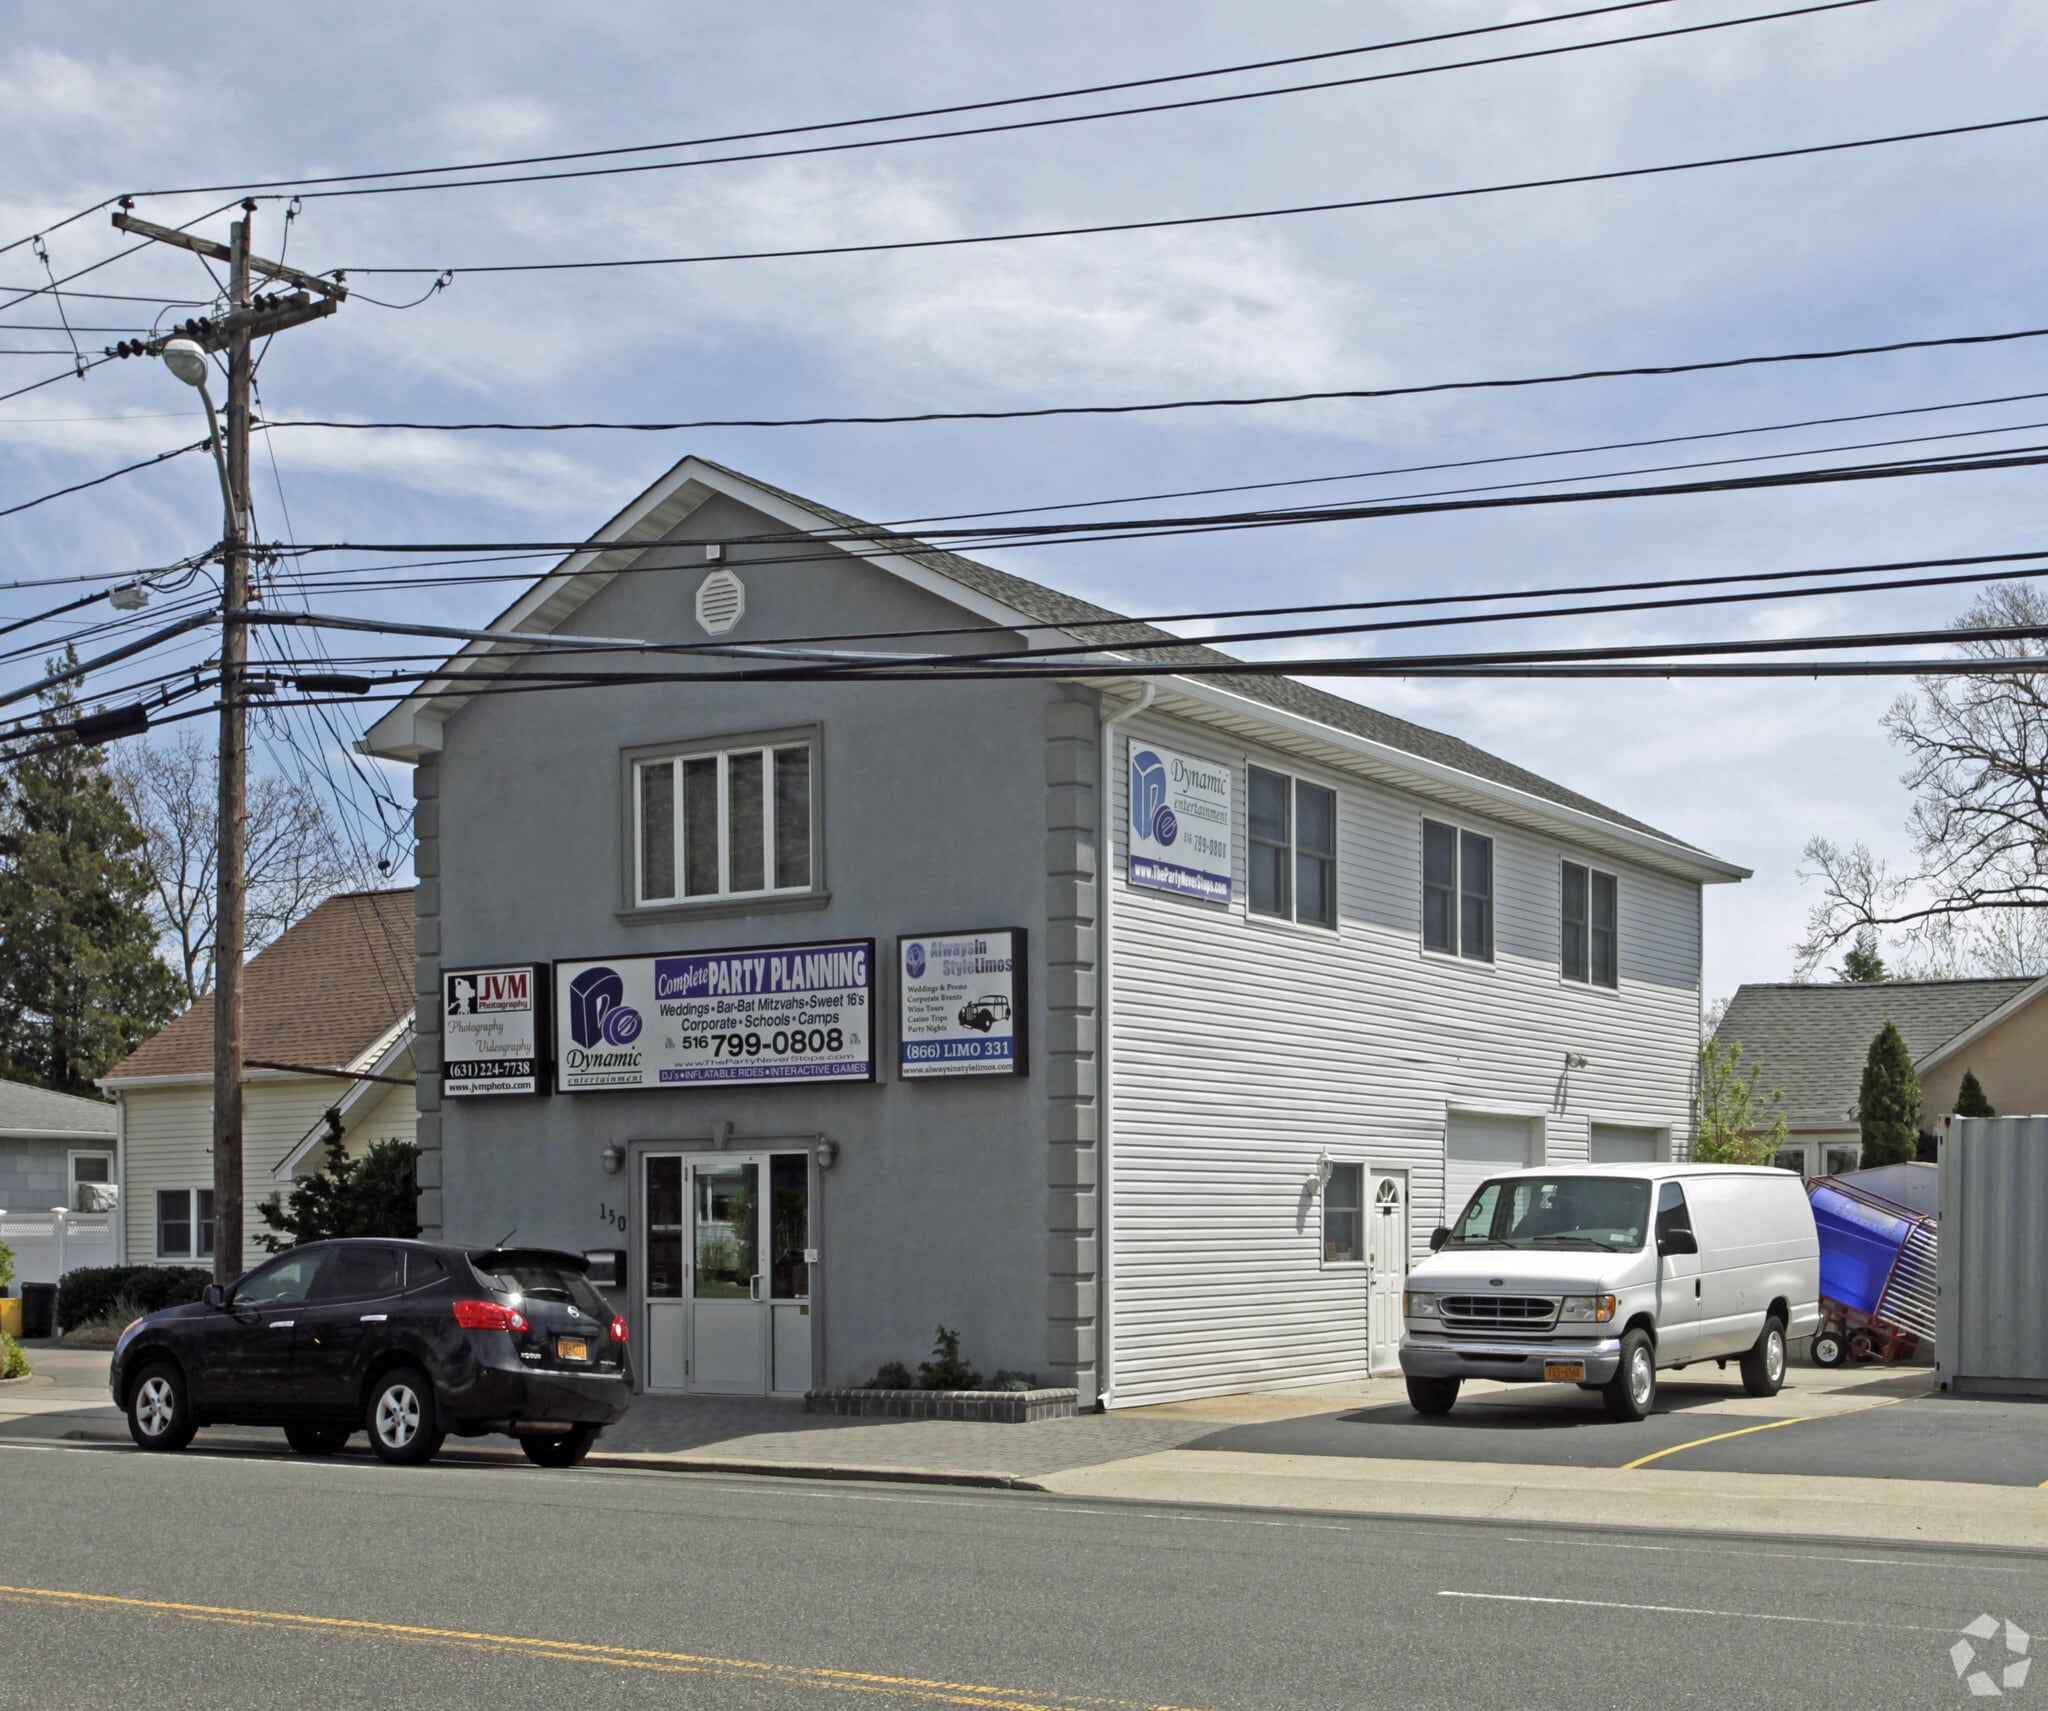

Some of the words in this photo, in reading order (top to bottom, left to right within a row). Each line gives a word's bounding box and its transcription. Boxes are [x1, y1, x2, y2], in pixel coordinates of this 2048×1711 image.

[1171, 758, 1227, 796] Dynamic
[1173, 799, 1228, 823] entertainment
[658, 965, 709, 996] Complete
[708, 958, 766, 995] PARTY
[770, 950, 866, 992] PLANNING
[479, 974, 528, 1001] JVM
[907, 984, 938, 994] Weddings
[479, 1000, 528, 1011] Photography
[660, 1003, 710, 1018] Weddings
[716, 999, 755, 1014] Bar-Bat
[757, 996, 805, 1012] Mitzvahs
[809, 994, 844, 1008] Sweet
[846, 992, 865, 1007] 16's
[907, 995, 940, 1005] Corporate
[907, 1005, 925, 1013] Wine
[926, 1005, 944, 1013] Tours
[447, 1018, 504, 1037] Photography
[681, 1017, 737, 1033] Corporate
[744, 1013, 791, 1028] Schools
[798, 1011, 840, 1027] Camps
[907, 1015, 930, 1023] Casino
[931, 1015, 948, 1024] Trips
[907, 1025, 925, 1034] Party
[926, 1024, 948, 1034] Nights
[475, 1038, 532, 1057] Videography
[682, 1035, 709, 1050] 516
[711, 1028, 844, 1057] 799-0808
[907, 1043, 941, 1060] (866)
[943, 1042, 981, 1058] LIMO
[984, 1041, 1009, 1056] 331
[480, 1061, 530, 1076] 224-7738
[566, 1046, 642, 1072] Dynamic
[661, 1070, 680, 1081] DJ's
[684, 1067, 737, 1080] INFLATABLE
[738, 1066, 764, 1078] RIDES
[770, 1064, 830, 1077] INTERACTIVE
[832, 1062, 867, 1074] GAMES
[903, 1063, 1013, 1076] www.alwaysinstylelimos.com
[448, 1081, 531, 1093] www.jvmphoto.com
[567, 1075, 643, 1084] entertainment
[600, 1202, 626, 1232] 150
